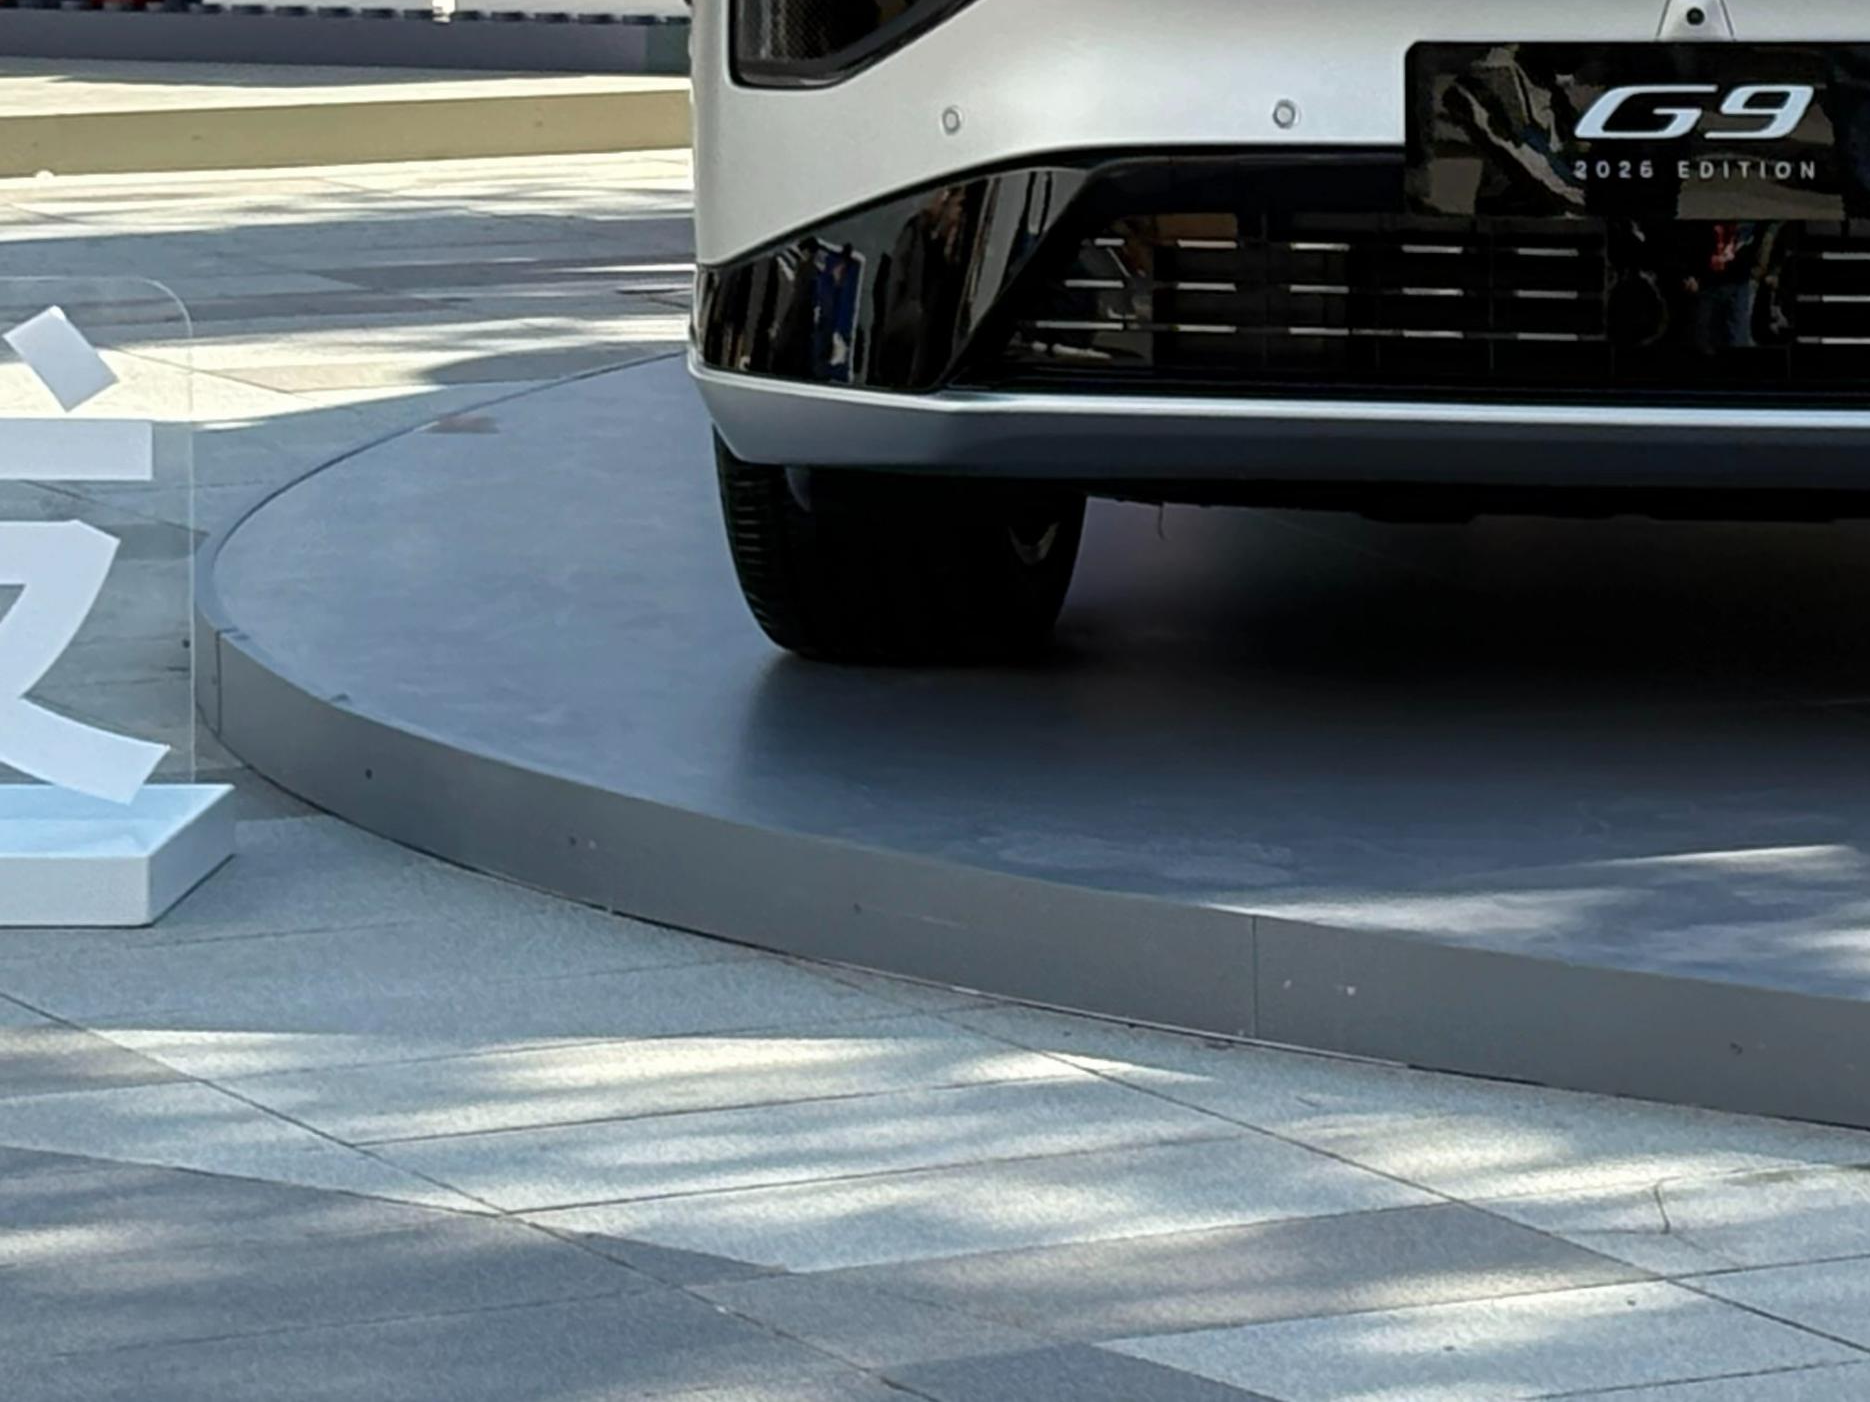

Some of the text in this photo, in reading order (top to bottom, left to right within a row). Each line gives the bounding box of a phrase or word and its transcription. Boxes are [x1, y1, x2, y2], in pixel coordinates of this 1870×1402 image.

[1574, 84, 1815, 140] G9
[1573, 160, 1817, 181] 2026 EDITION
